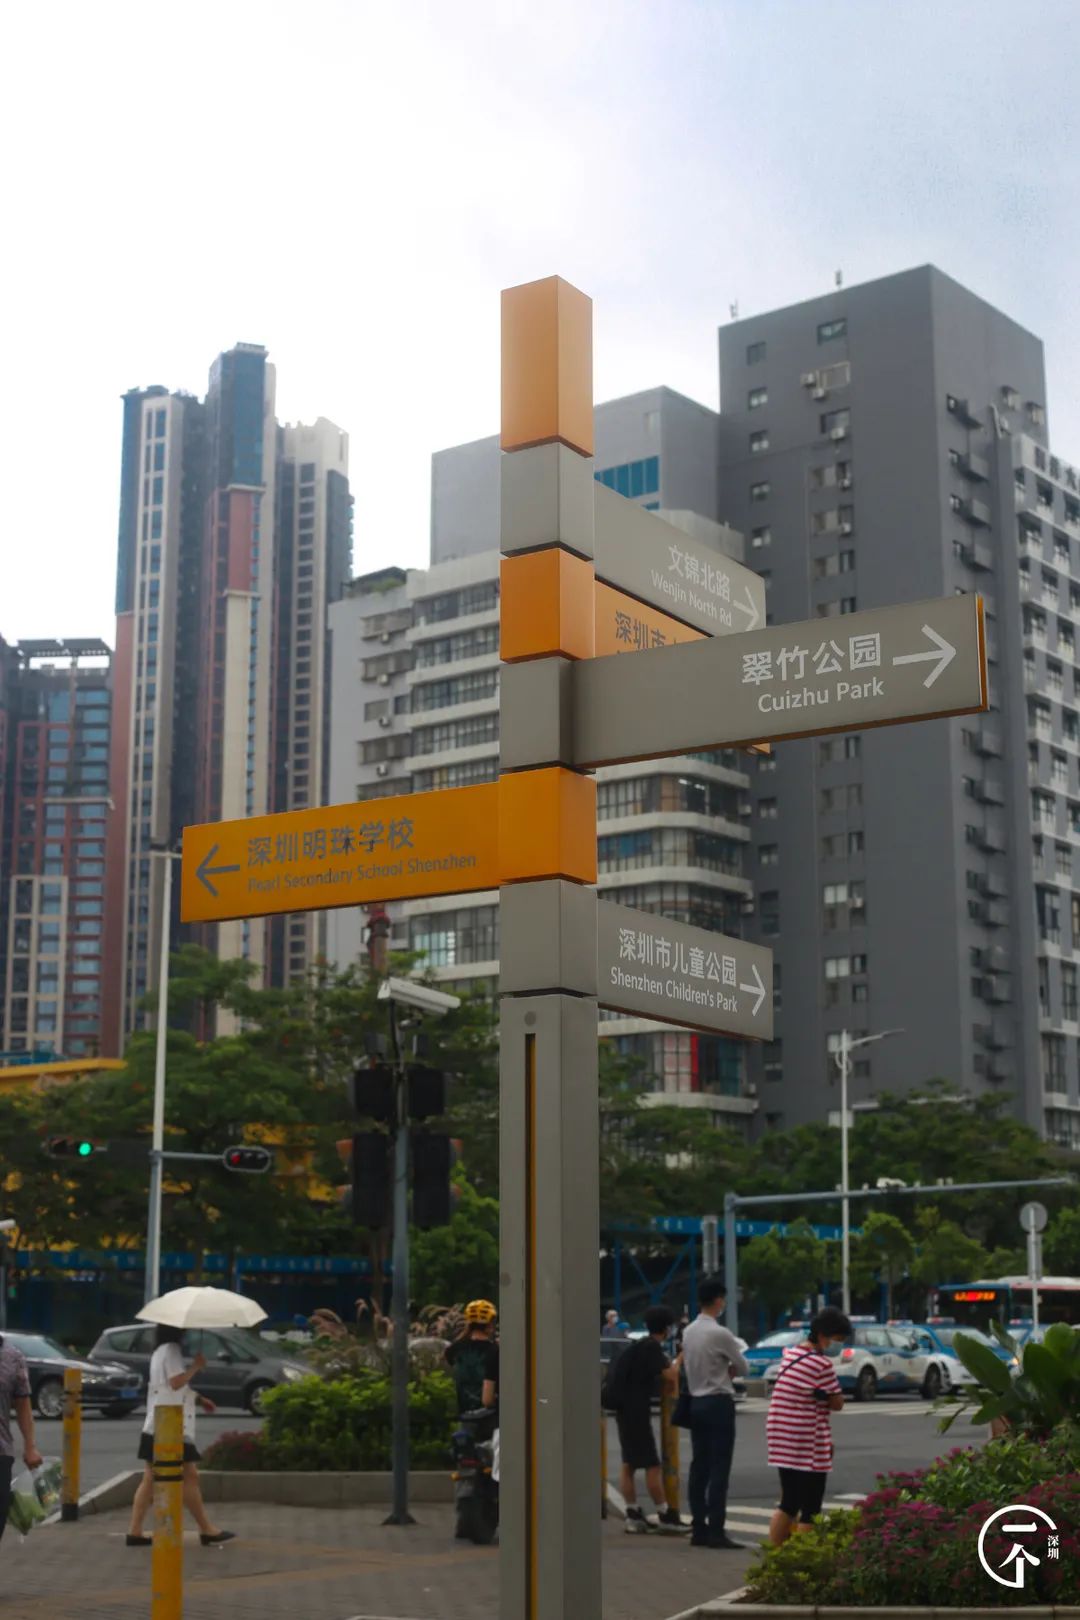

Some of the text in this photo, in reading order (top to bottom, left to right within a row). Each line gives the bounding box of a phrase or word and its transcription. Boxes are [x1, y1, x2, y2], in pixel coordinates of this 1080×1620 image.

[651, 569, 732, 627] Wenjin North Rd
[668, 544, 730, 602] 文锦北路
[614, 609, 677, 650] 深圳市
[742, 632, 881, 685] 翠竹公园
[758, 676, 885, 713] Cuizhu Park
[247, 816, 415, 868] 深圳明珠学校
[248, 853, 477, 893] Pearl Secondary School Shenzhen
[618, 927, 737, 987] 深圳市儿童公园
[610, 966, 738, 1013] Shenzhen Children's Park
